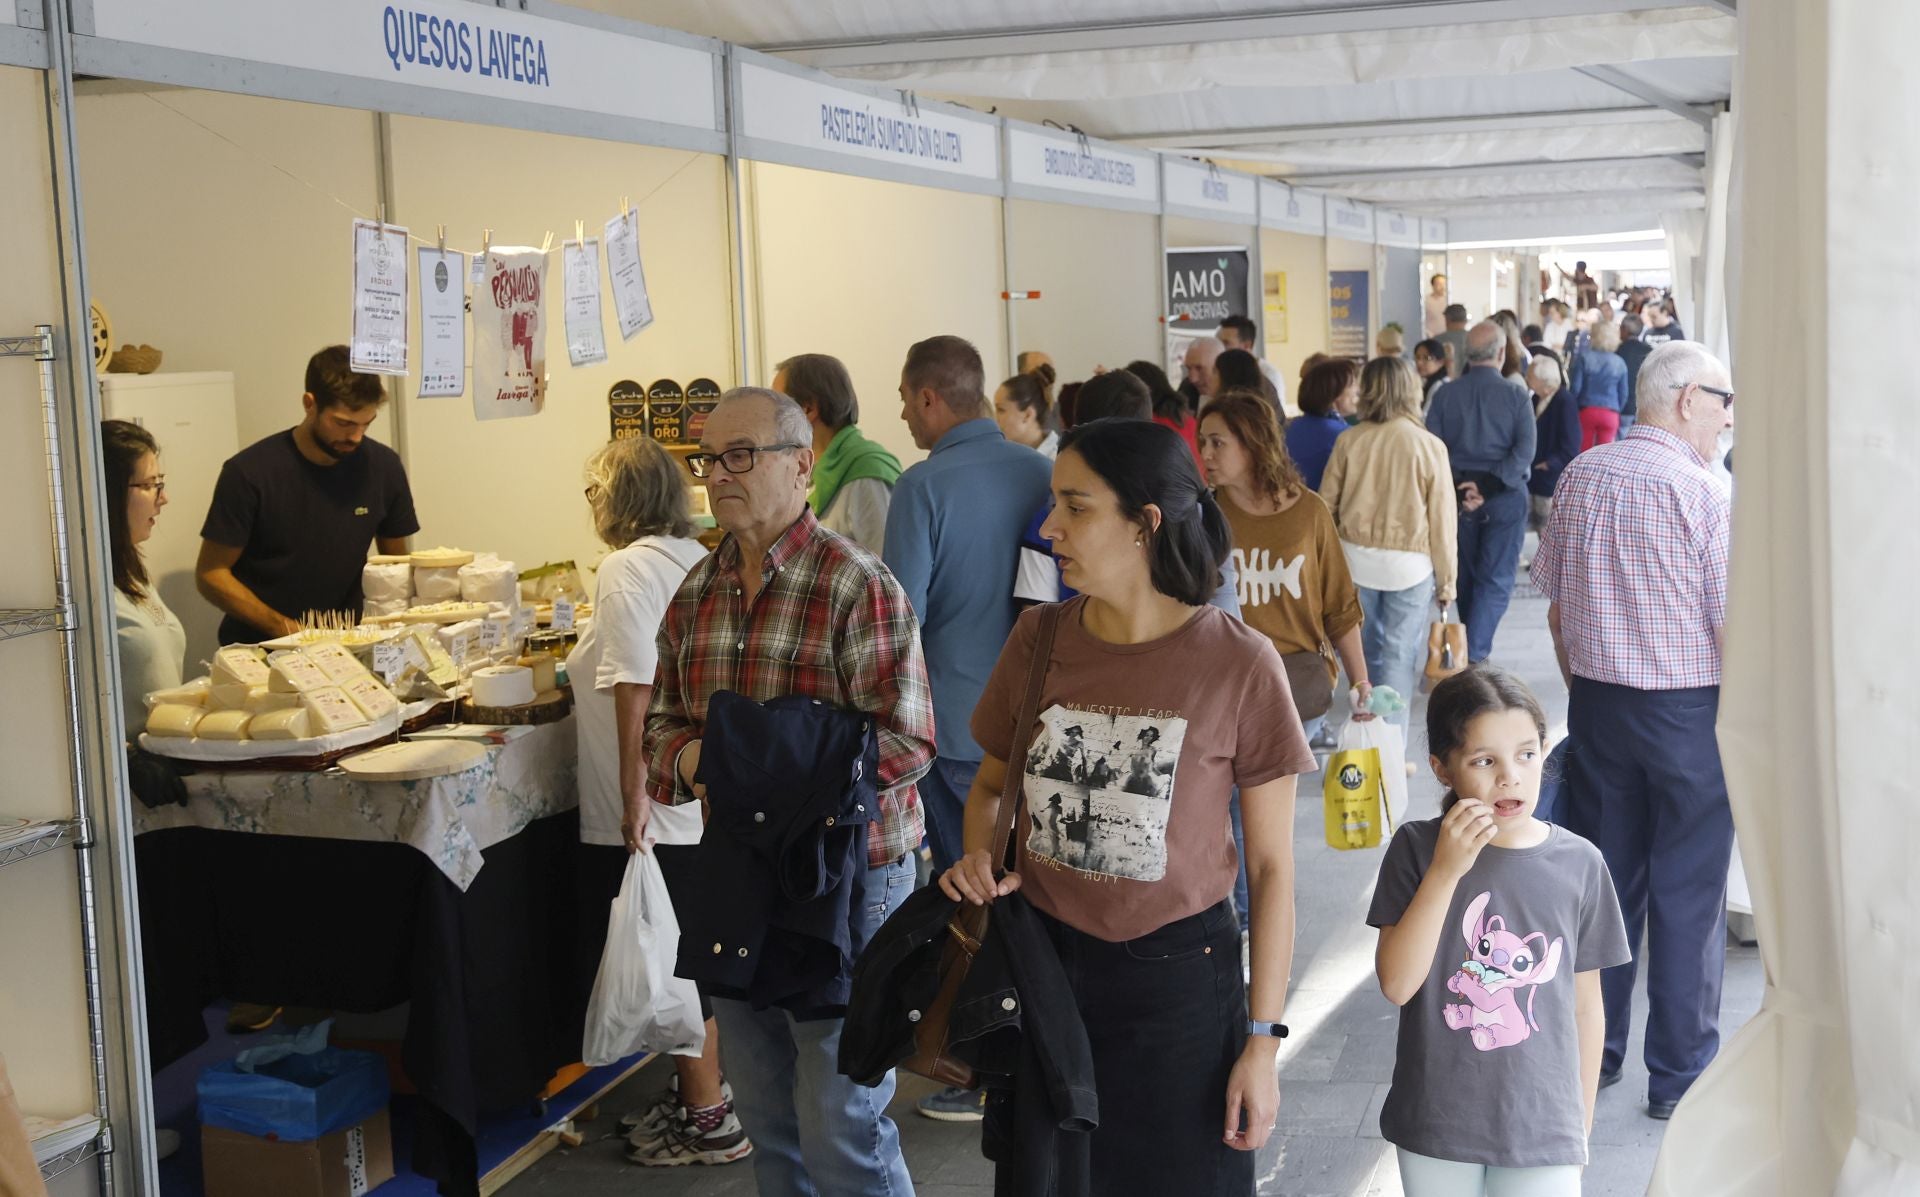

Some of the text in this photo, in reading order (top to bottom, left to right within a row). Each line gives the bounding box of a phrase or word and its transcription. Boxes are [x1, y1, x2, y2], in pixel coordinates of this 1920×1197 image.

[384, 5, 549, 87] QUESOS LAVEGA
[821, 103, 962, 163] PASTELERÍA SUMENDI SIN GLUTEN
[1172, 268, 1226, 299] AMO
[653, 416, 680, 425] Cincho
[616, 428, 641, 440] ORO
[654, 426, 680, 438] ORO
